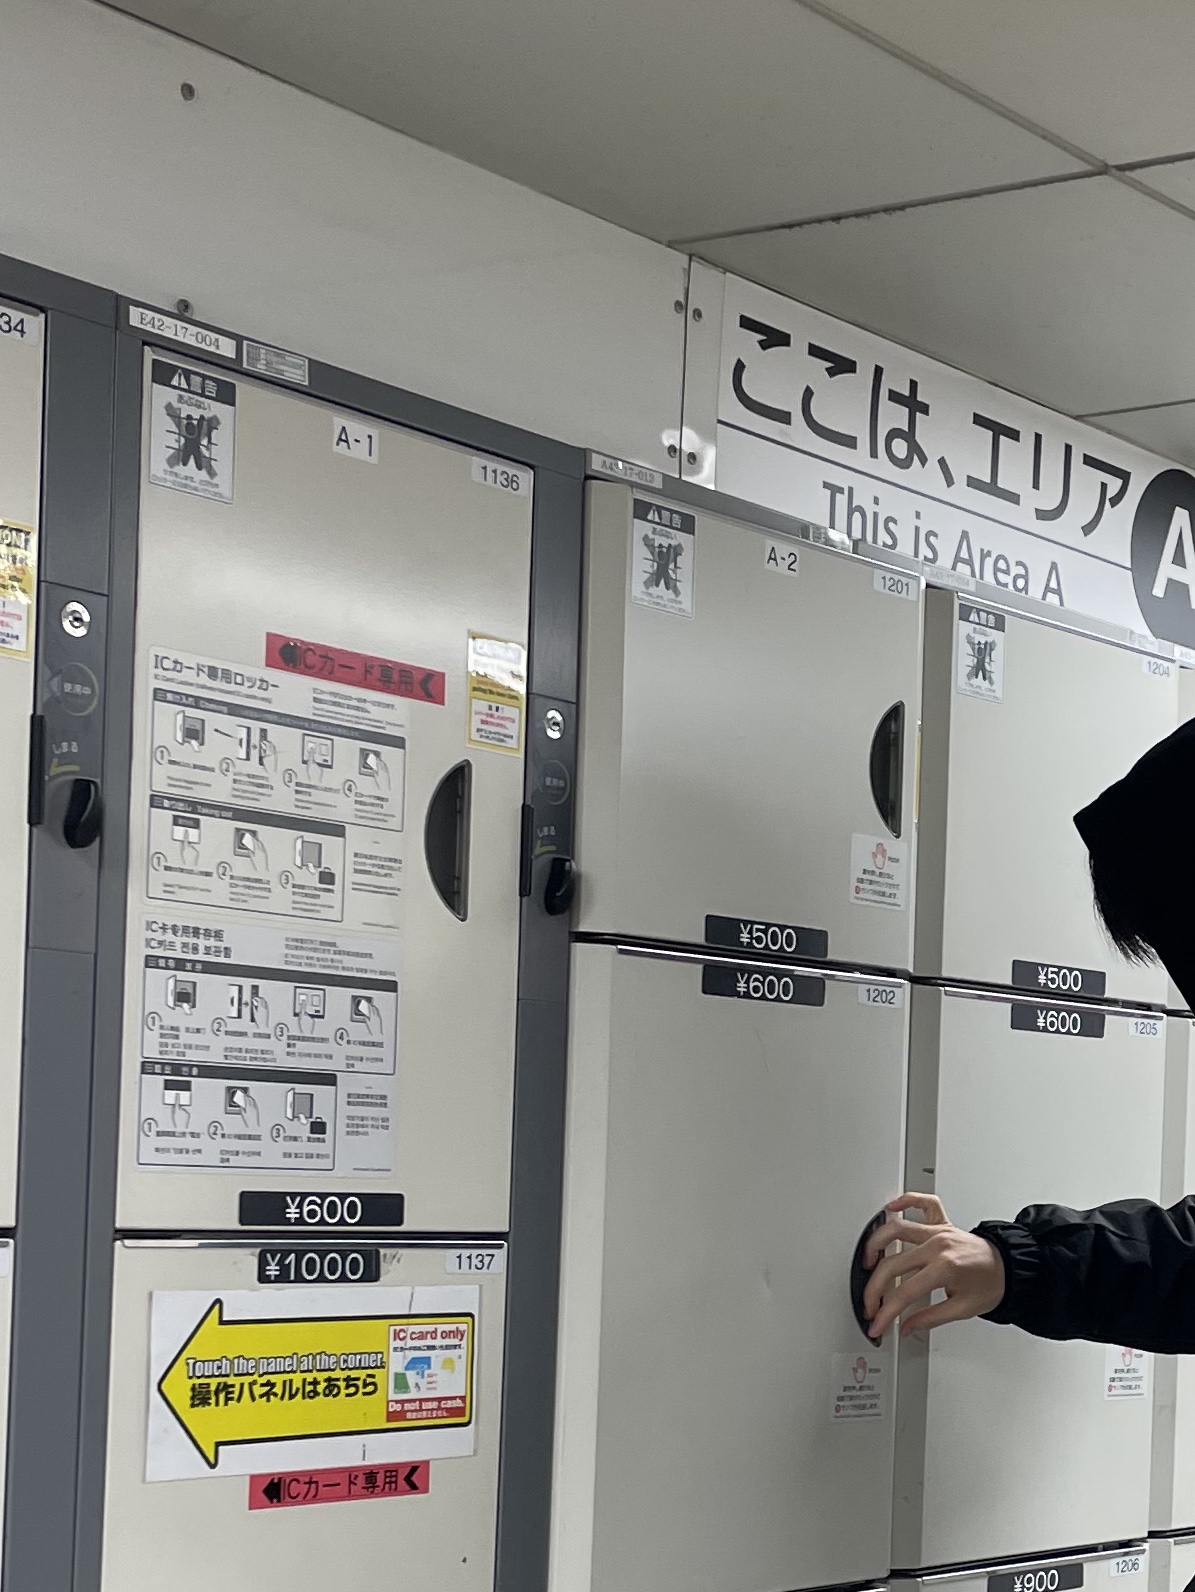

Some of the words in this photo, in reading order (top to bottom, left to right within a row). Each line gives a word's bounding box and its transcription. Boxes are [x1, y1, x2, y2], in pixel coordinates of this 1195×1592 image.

[139, 311, 221, 351] E42-17-004
[732, 313, 1132, 537] ここは、エリア
[335, 425, 374, 458] A-1
[479, 463, 521, 492] 1136
[822, 479, 899, 552] This
[912, 511, 940, 563] is
[951, 529, 1030, 596] Area
[1041, 560, 1065, 607] A
[766, 546, 798, 573] A-2
[881, 574, 911, 596] 1201
[154, 654, 280, 692] ICカード専用ロッカー
[1147, 660, 1171, 678] 1204
[739, 922, 797, 952] ¥500
[736, 972, 794, 1001] ¥600
[1037, 965, 1082, 992] ¥500
[865, 987, 896, 1005] 1202
[1036, 1009, 1081, 1034] ¥600
[1134, 1020, 1158, 1036] 1205
[285, 1195, 363, 1223] ¥600
[264, 1252, 365, 1281] ¥1000
[456, 1254, 495, 1271] 1137
[393, 1327, 407, 1341] IC
[409, 1326, 438, 1341] card
[440, 1326, 467, 1342] only
[186, 1358, 230, 1379] Touch
[233, 1355, 256, 1376] the
[258, 1354, 298, 1379] panel
[300, 1353, 314, 1374] at
[316, 1352, 338, 1373] the
[339, 1350, 386, 1371] corner.
[189, 1374, 379, 1409] 操作パネルはあちら
[388, 1401, 402, 1412] Do
[404, 1401, 420, 1411] not
[422, 1400, 439, 1410] use
[441, 1397, 466, 1409] cash.
[282, 1469, 400, 1501] ICカード専用
[1115, 1557, 1140, 1574] 1206
